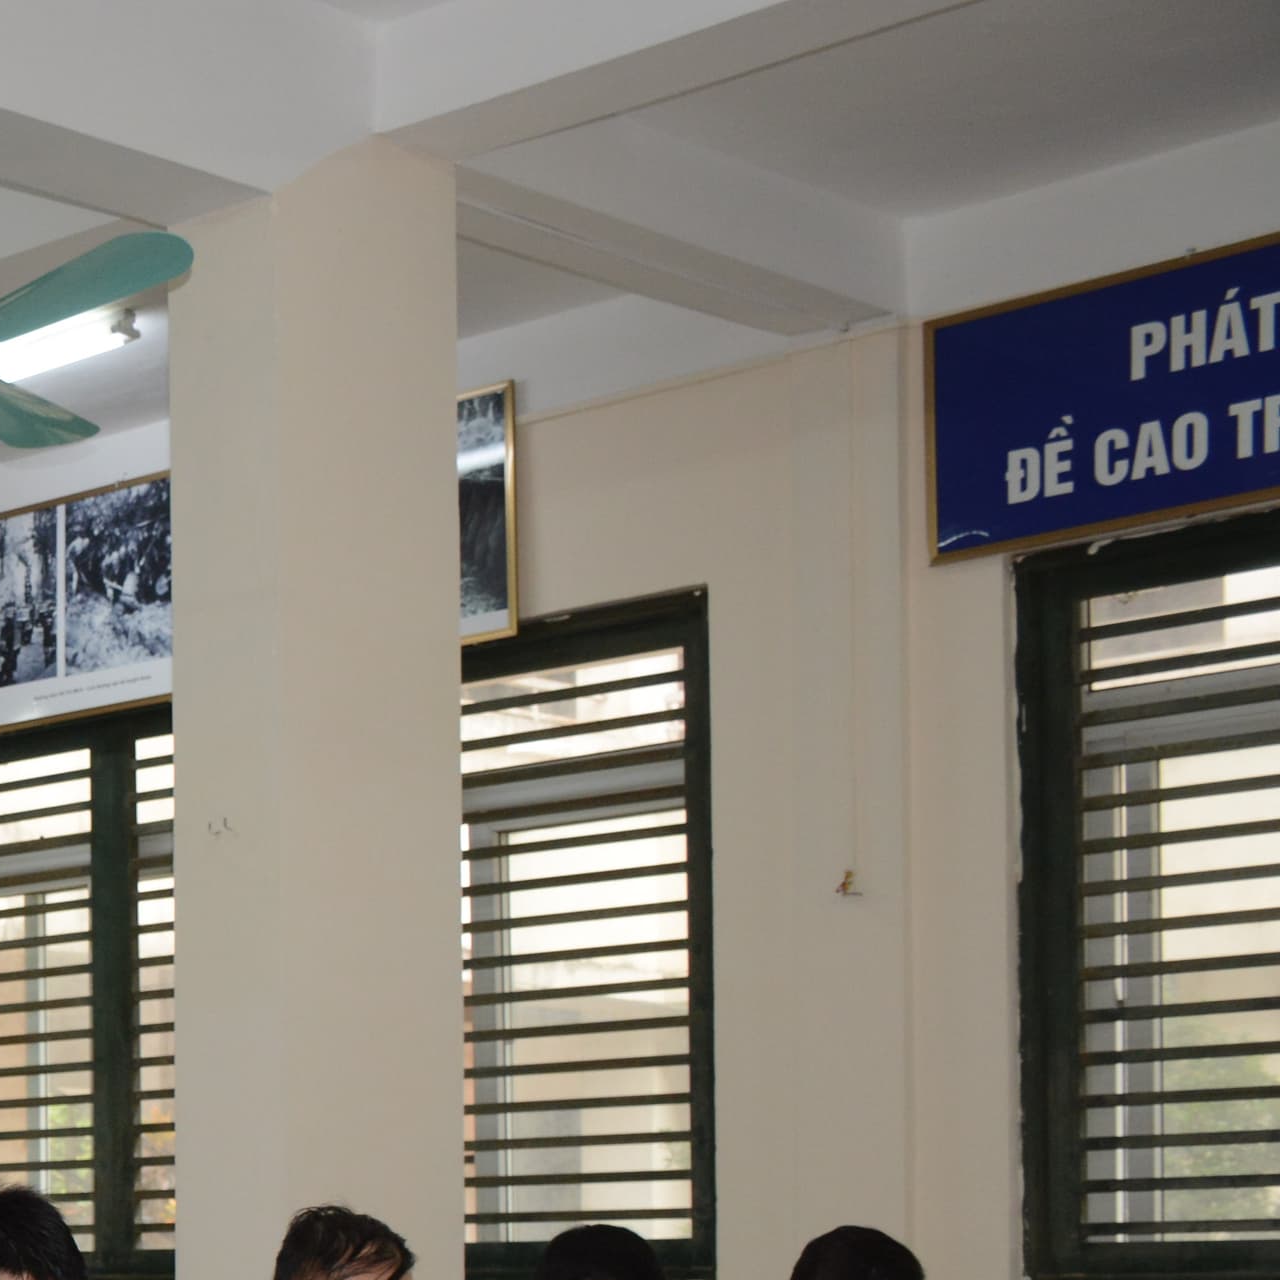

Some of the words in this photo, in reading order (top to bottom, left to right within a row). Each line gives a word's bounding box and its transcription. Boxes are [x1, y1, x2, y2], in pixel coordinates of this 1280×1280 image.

[1130, 287, 1280, 381] PHÁT
[1005, 415, 1074, 505] ĐỀ
[1094, 411, 1209, 487] CAO
